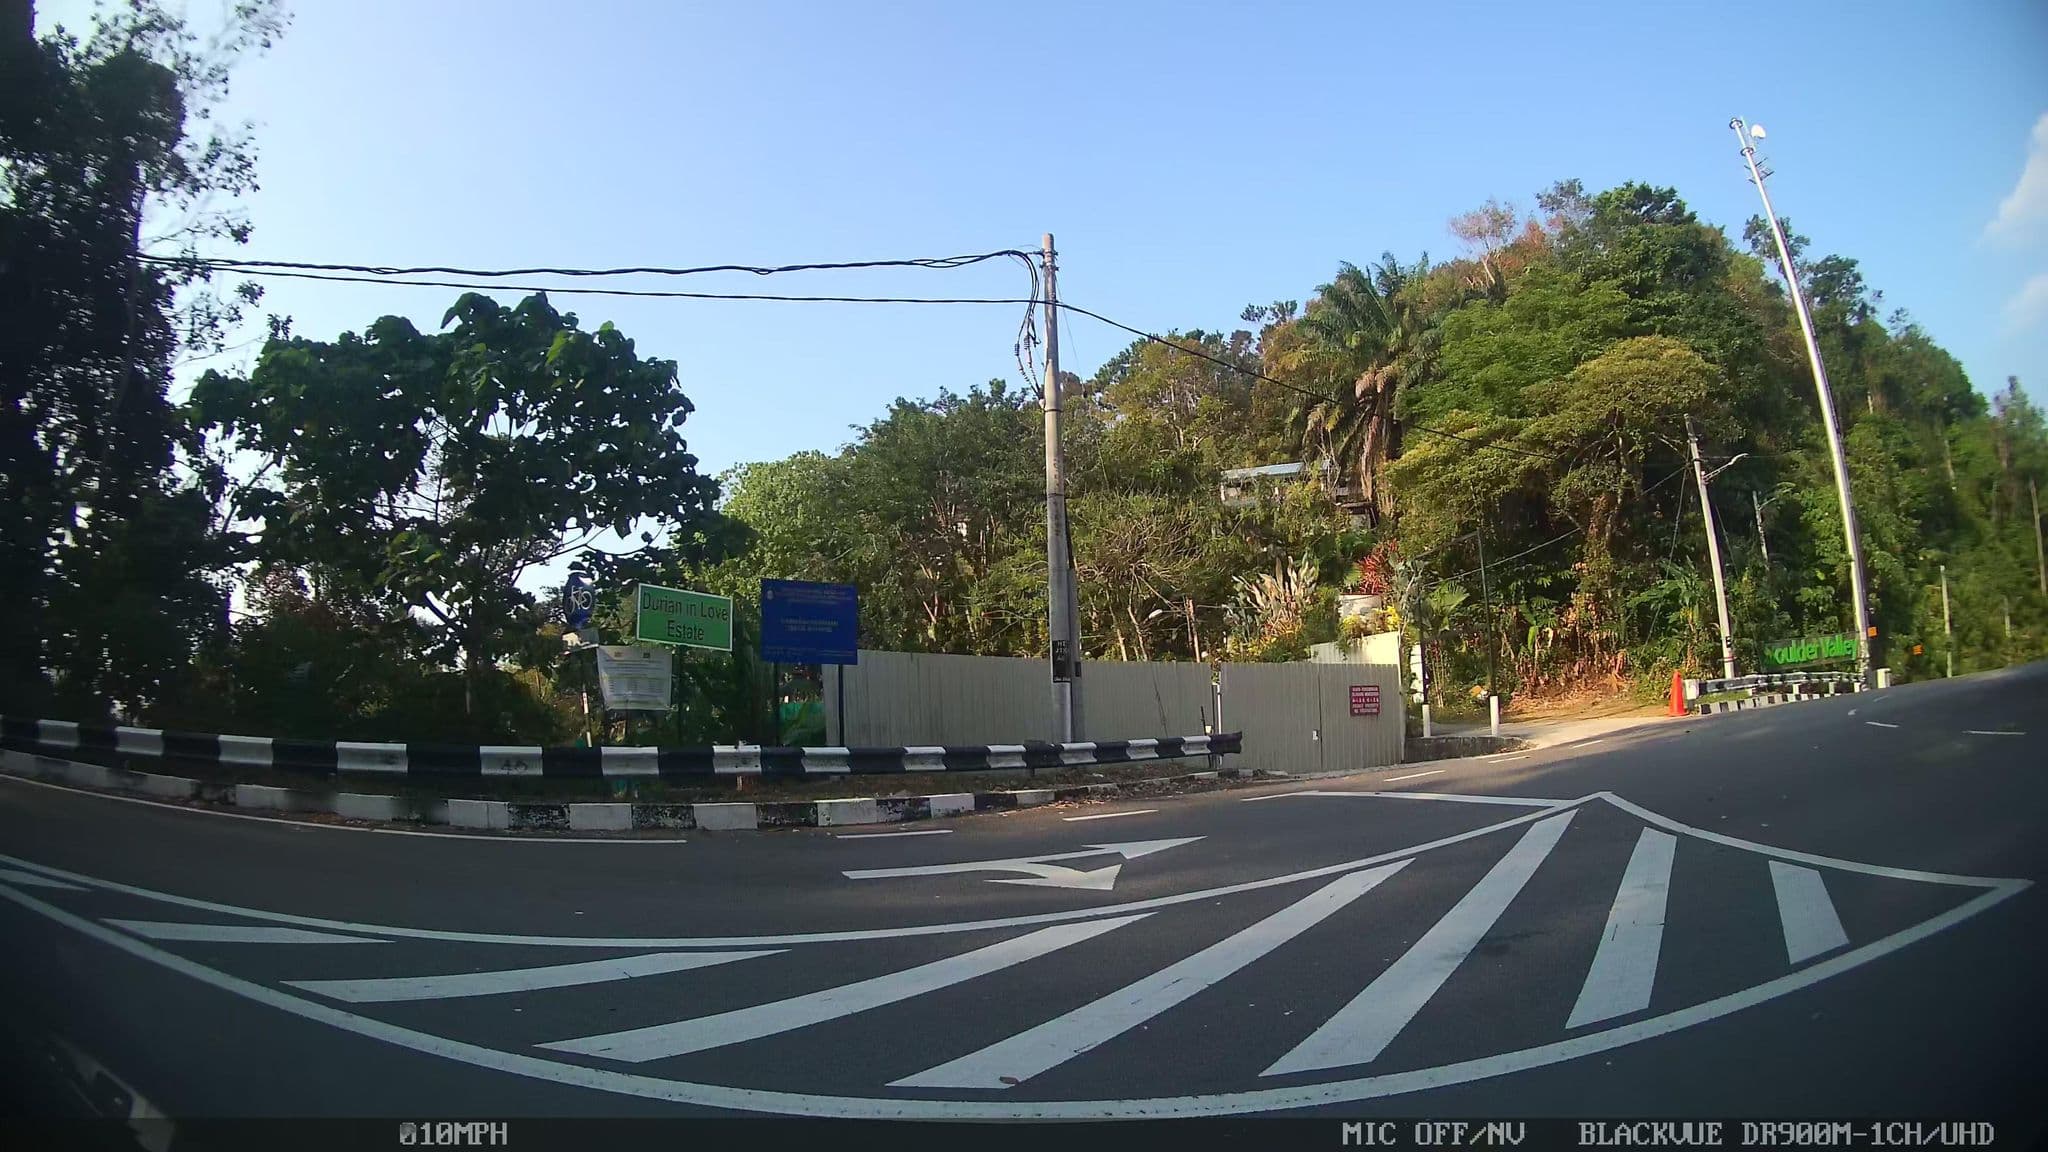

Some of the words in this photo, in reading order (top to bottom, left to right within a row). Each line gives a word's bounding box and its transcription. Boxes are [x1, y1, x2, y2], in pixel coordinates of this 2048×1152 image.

[643, 592, 682, 615] Durian
[687, 600, 697, 616] in
[701, 602, 728, 621] Love
[667, 620, 704, 641] Estate
[1766, 639, 1819, 665] oulder
[1820, 634, 1857, 661] Valley
